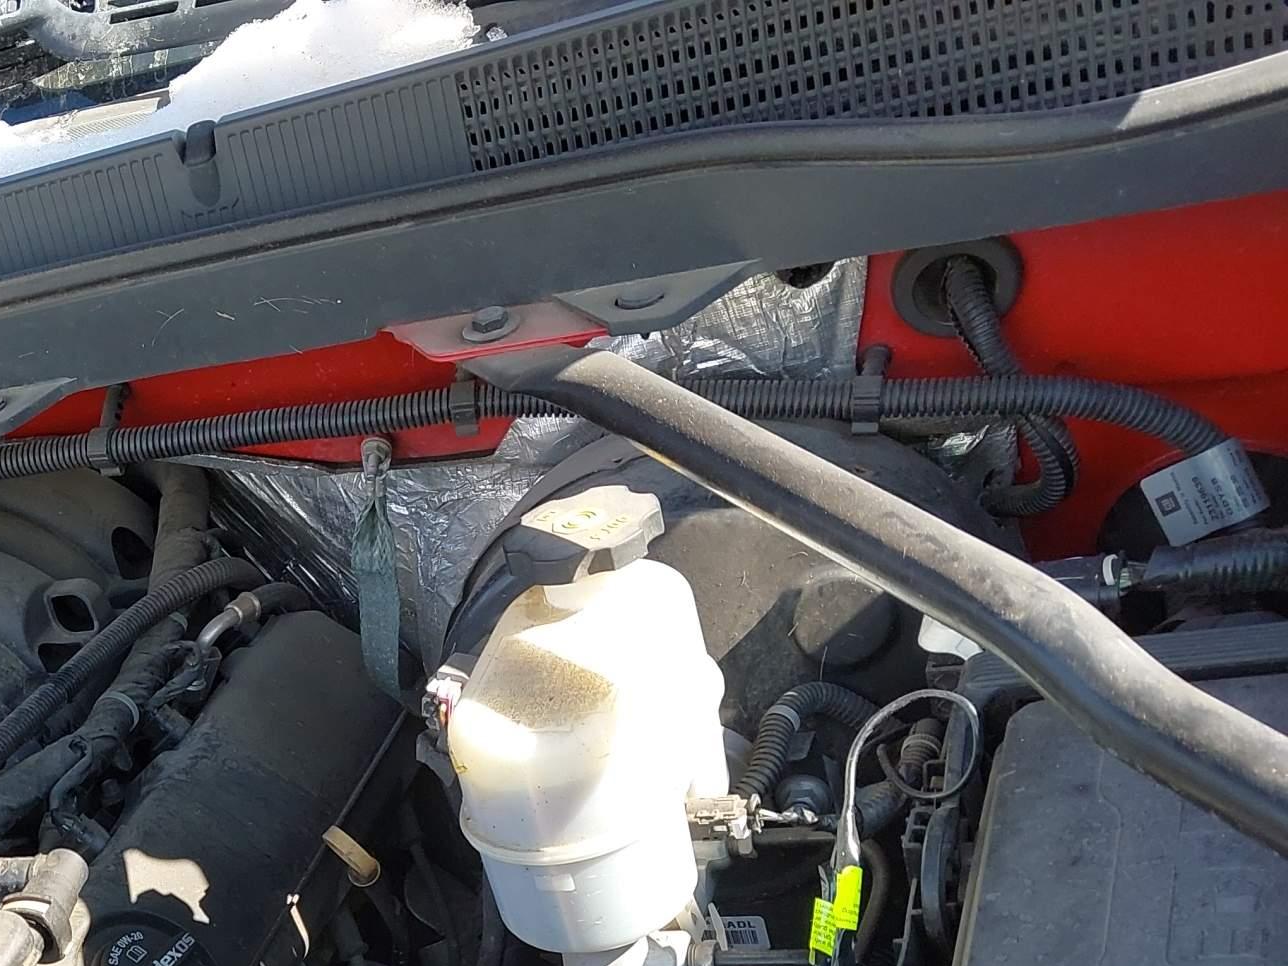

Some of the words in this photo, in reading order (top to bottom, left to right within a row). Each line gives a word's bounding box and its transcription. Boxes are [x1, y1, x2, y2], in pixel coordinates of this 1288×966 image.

[724, 921, 756, 929] ADL
[108, 946, 122, 966] SAE
[117, 931, 144, 948] 0W-20
